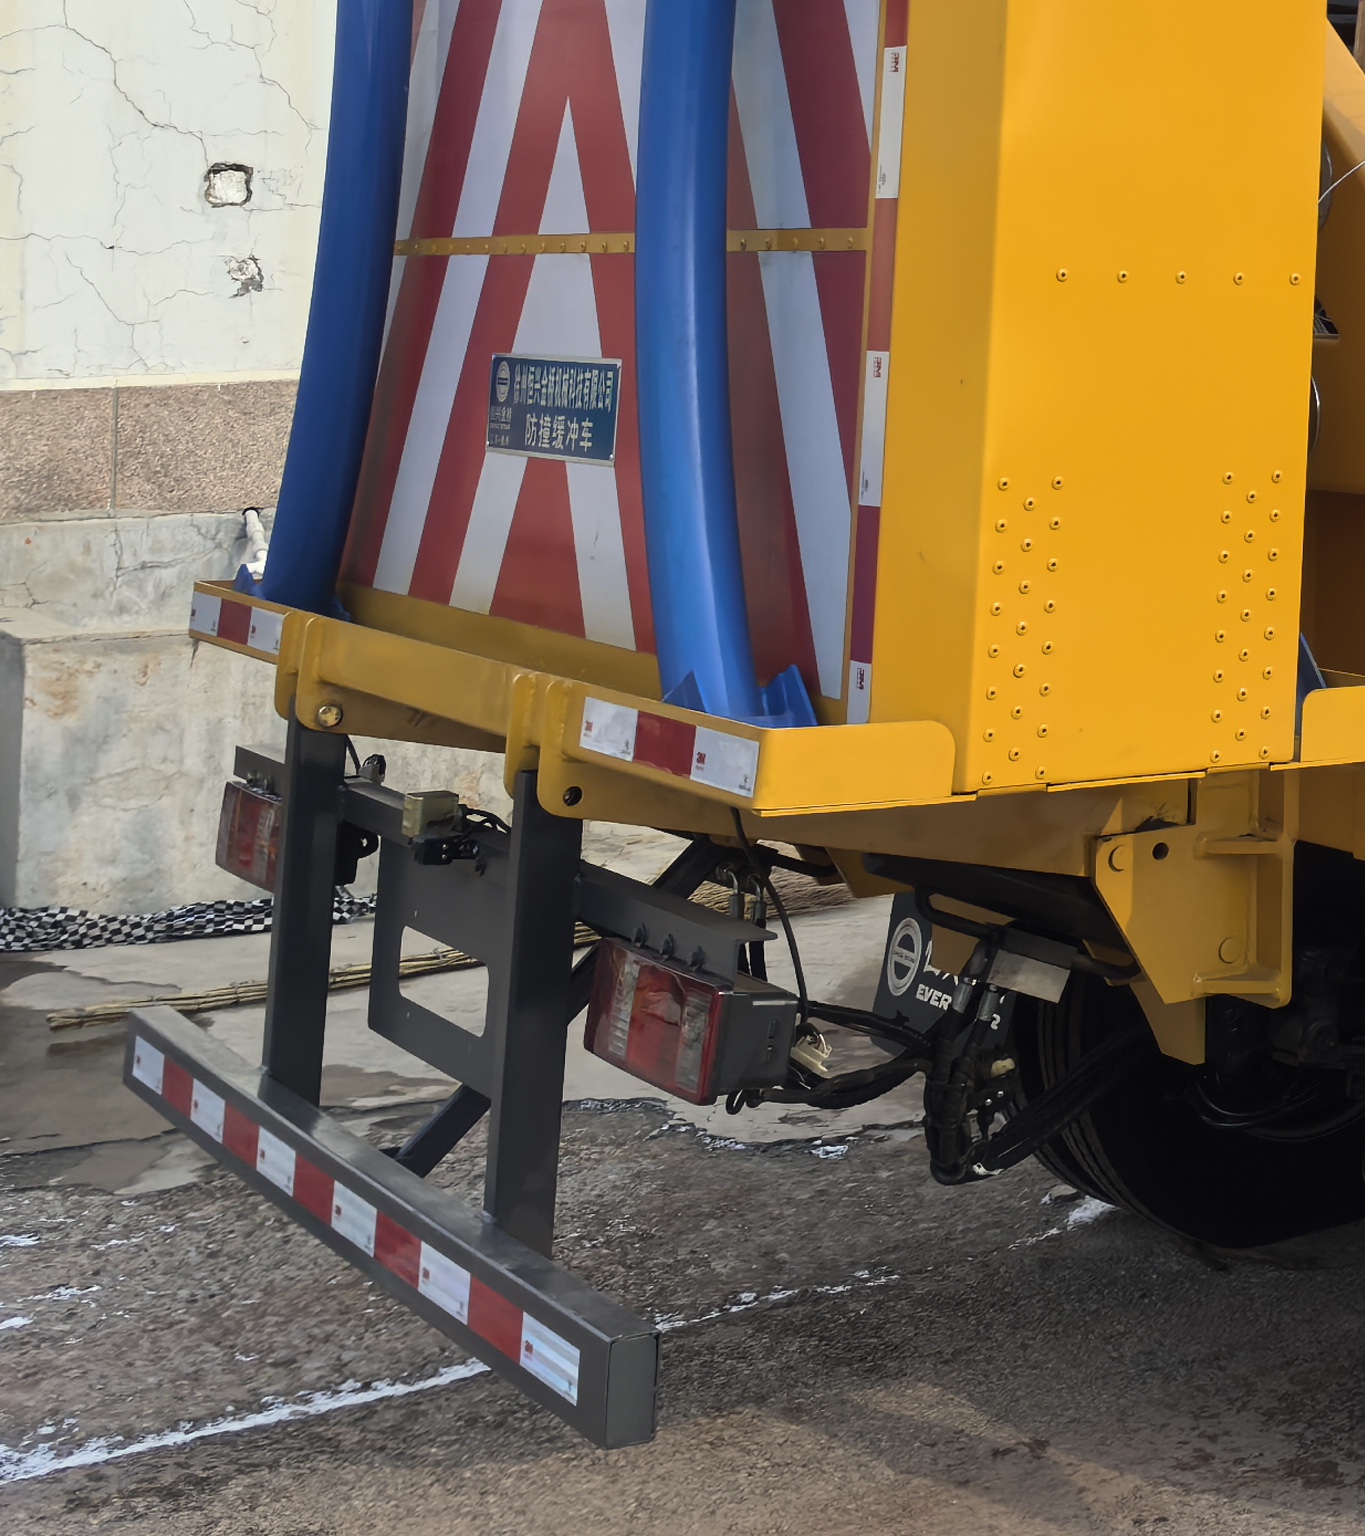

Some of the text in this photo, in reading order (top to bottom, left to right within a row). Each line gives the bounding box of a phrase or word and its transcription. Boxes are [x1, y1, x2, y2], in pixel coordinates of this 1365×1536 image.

[524, 412, 594, 452] 防撞缓冲车
